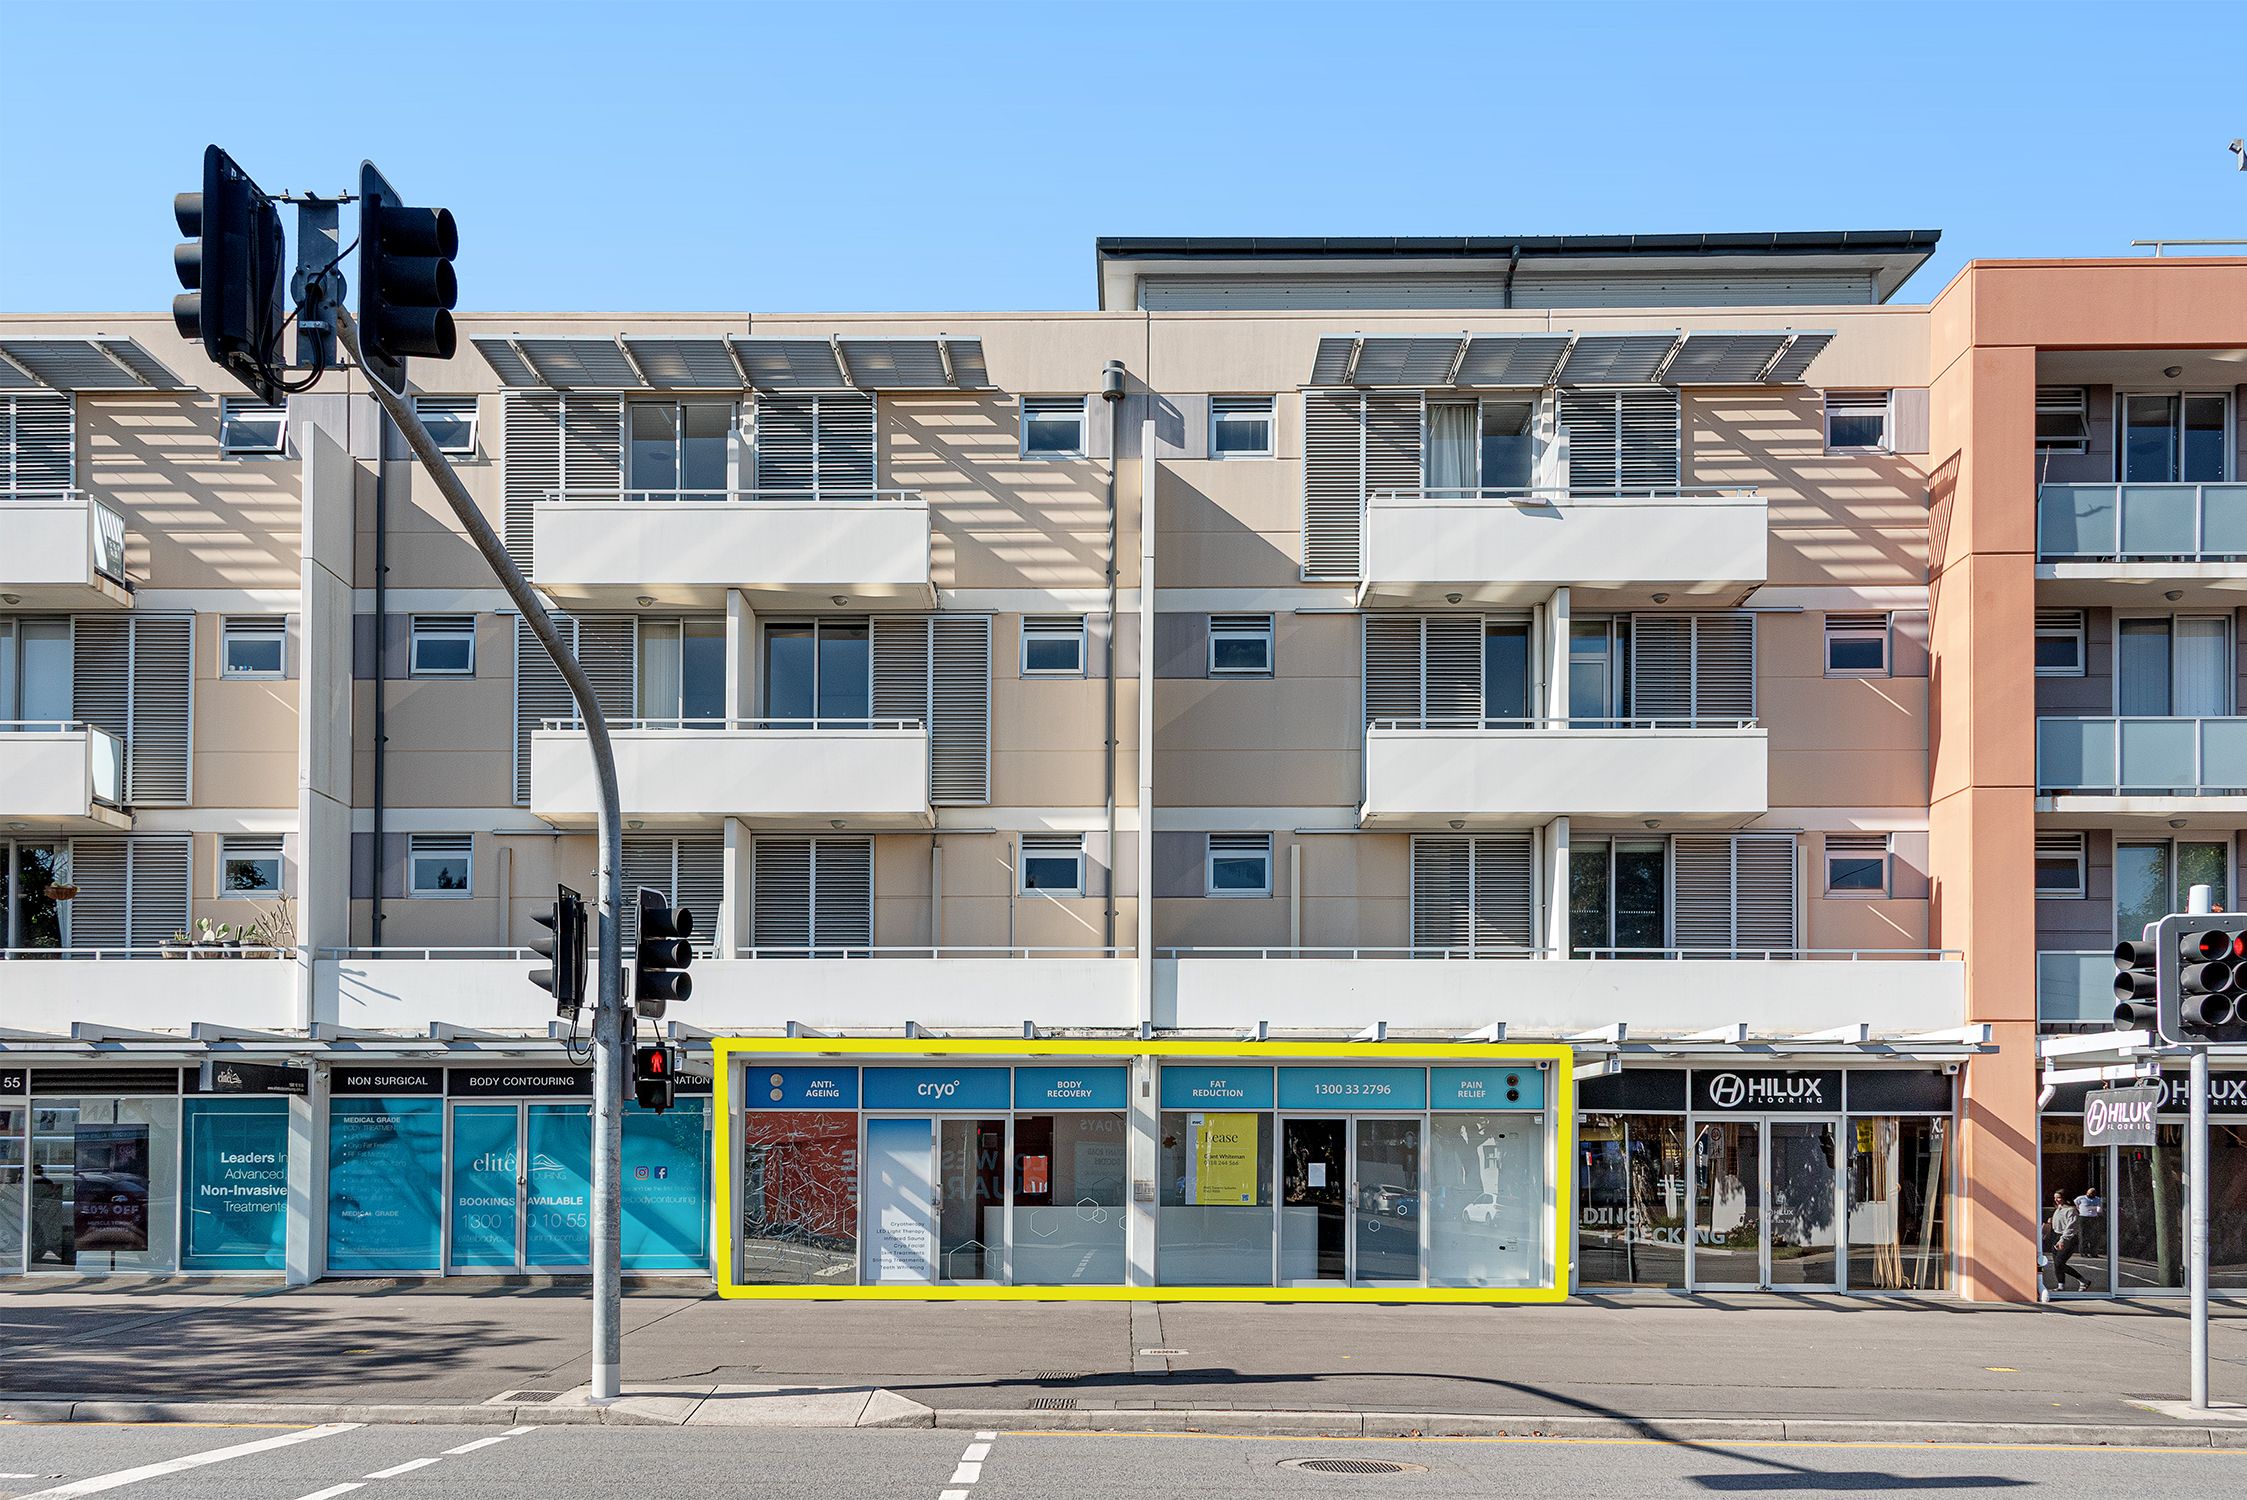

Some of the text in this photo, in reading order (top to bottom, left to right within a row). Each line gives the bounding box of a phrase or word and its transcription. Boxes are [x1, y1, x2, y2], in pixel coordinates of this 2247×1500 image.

[4, 1077, 21, 1088] 55
[348, 1076, 428, 1086] NON SURGICAL
[470, 1077, 575, 1086] BODY CONTOURING
[673, 1076, 710, 1085] NATION
[810, 1080, 835, 1089] ANTI-
[1210, 1080, 1226, 1088] FAT
[1314, 1084, 1391, 1094] 1300 33 2796
[1749, 1078, 1822, 1097] HILUX
[2172, 1080, 2247, 1099] HUX
[806, 1089, 839, 1098] AGEING
[1192, 1089, 1243, 1097] REDUCTION
[2108, 1101, 2153, 1123] HILUX
[221, 1152, 275, 1163] Leaders
[473, 1152, 515, 1171] elite
[201, 1184, 288, 1195] Non-Invasive
[224, 1200, 288, 1212] Treatments
[460, 1196, 583, 1206] BOOKINGS AVAILABLE
[112, 1205, 140, 1214] OFF
[461, 1214, 502, 1229] 1300
[543, 1213, 561, 1227] 10
[566, 1213, 587, 1228] 55
[1584, 1207, 1640, 1225] DING
